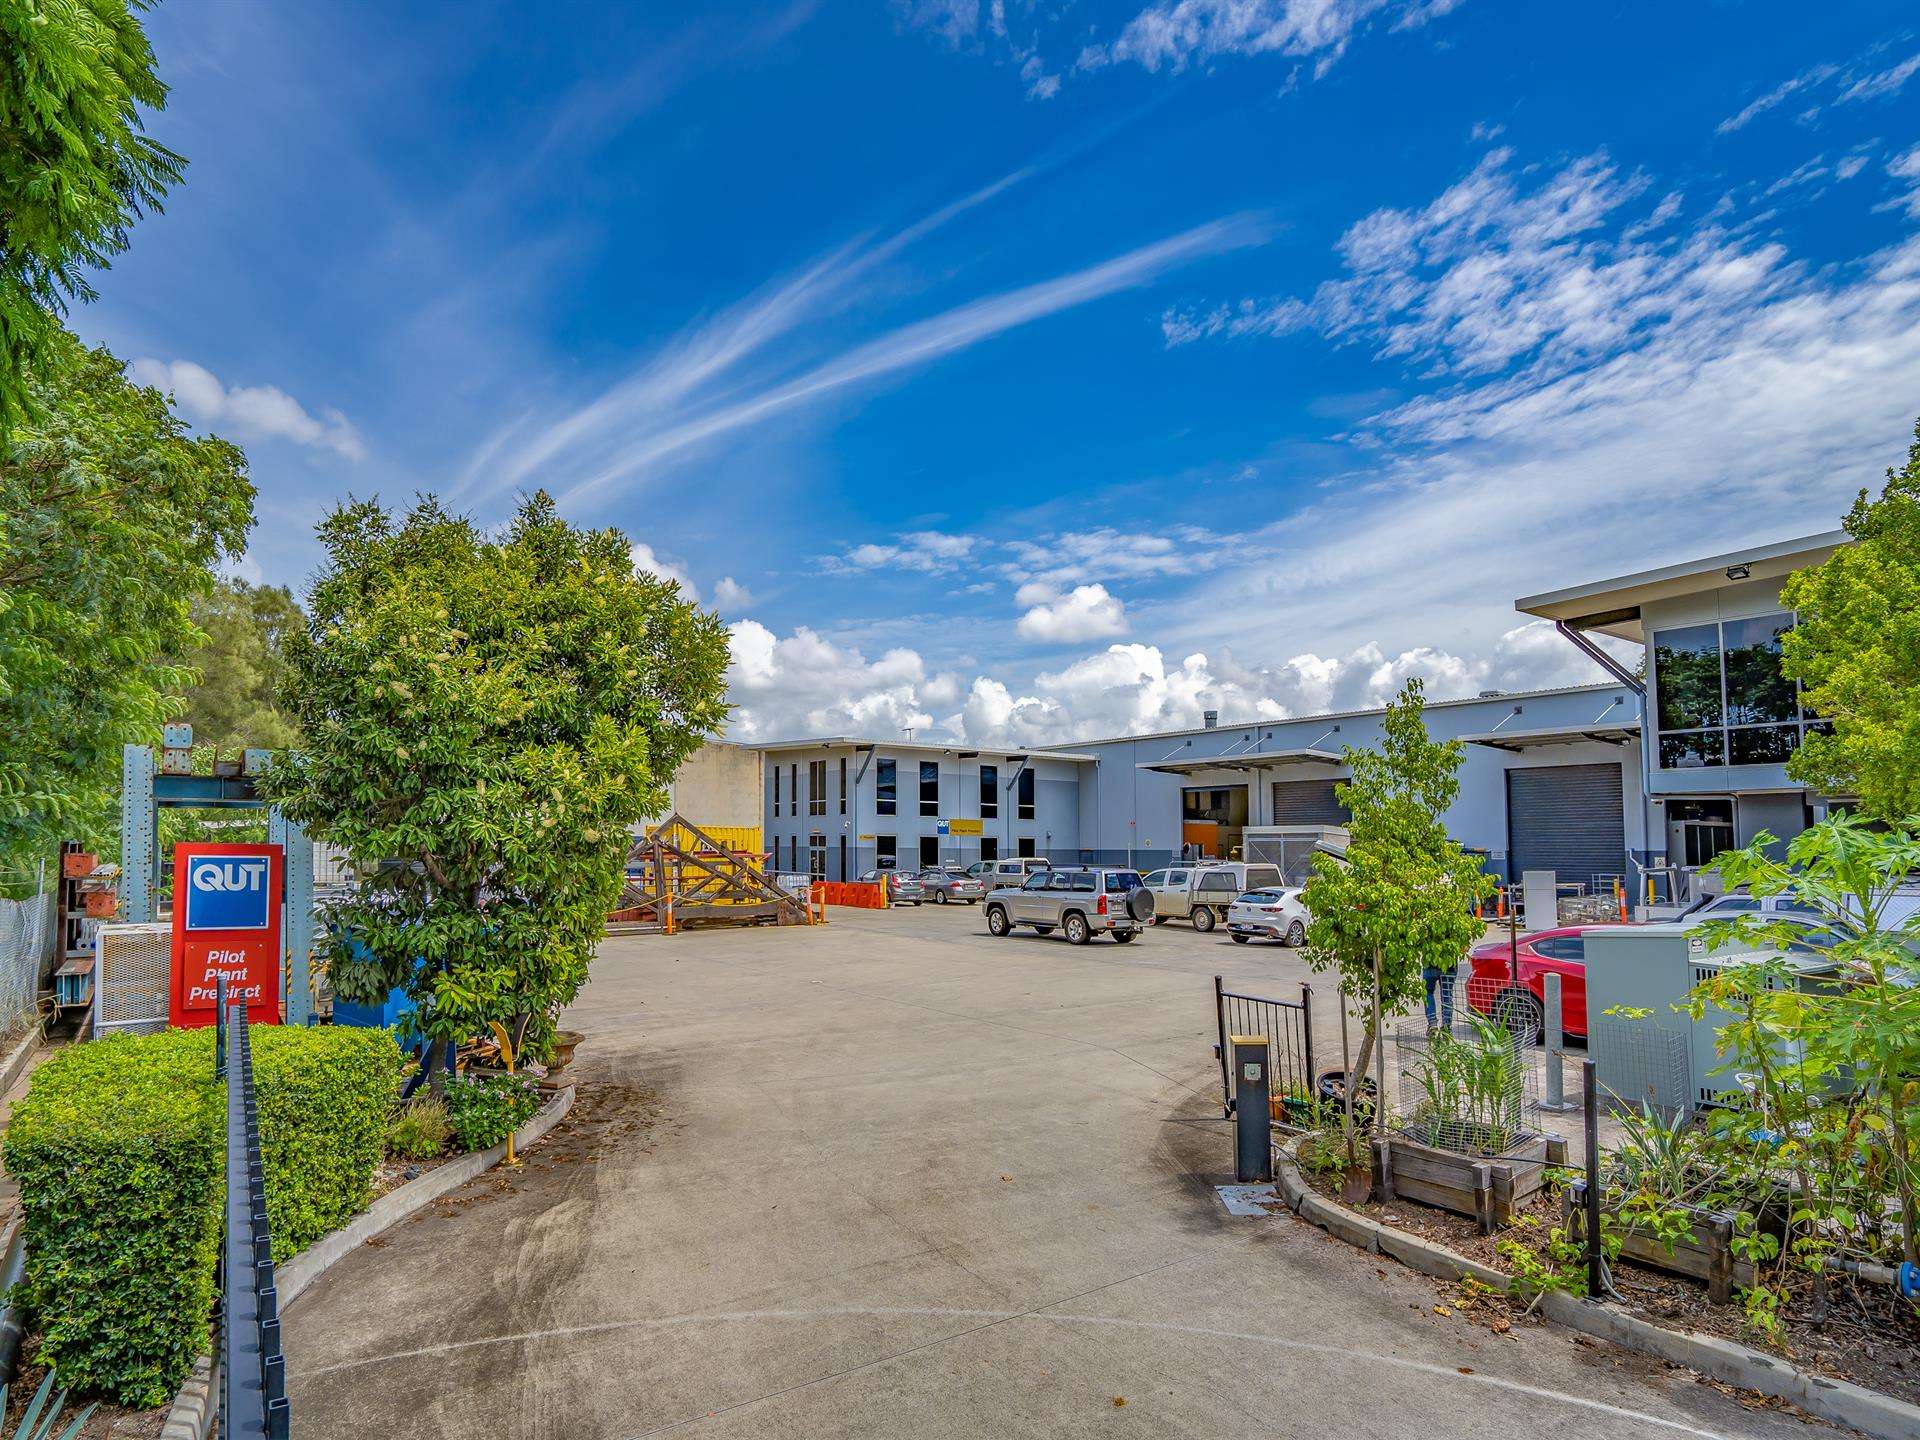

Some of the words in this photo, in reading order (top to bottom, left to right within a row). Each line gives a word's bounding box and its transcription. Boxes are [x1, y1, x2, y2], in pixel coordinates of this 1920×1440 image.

[193, 863, 265, 891] QUT
[206, 950, 246, 964] Pilot
[188, 984, 261, 1001] Preict
